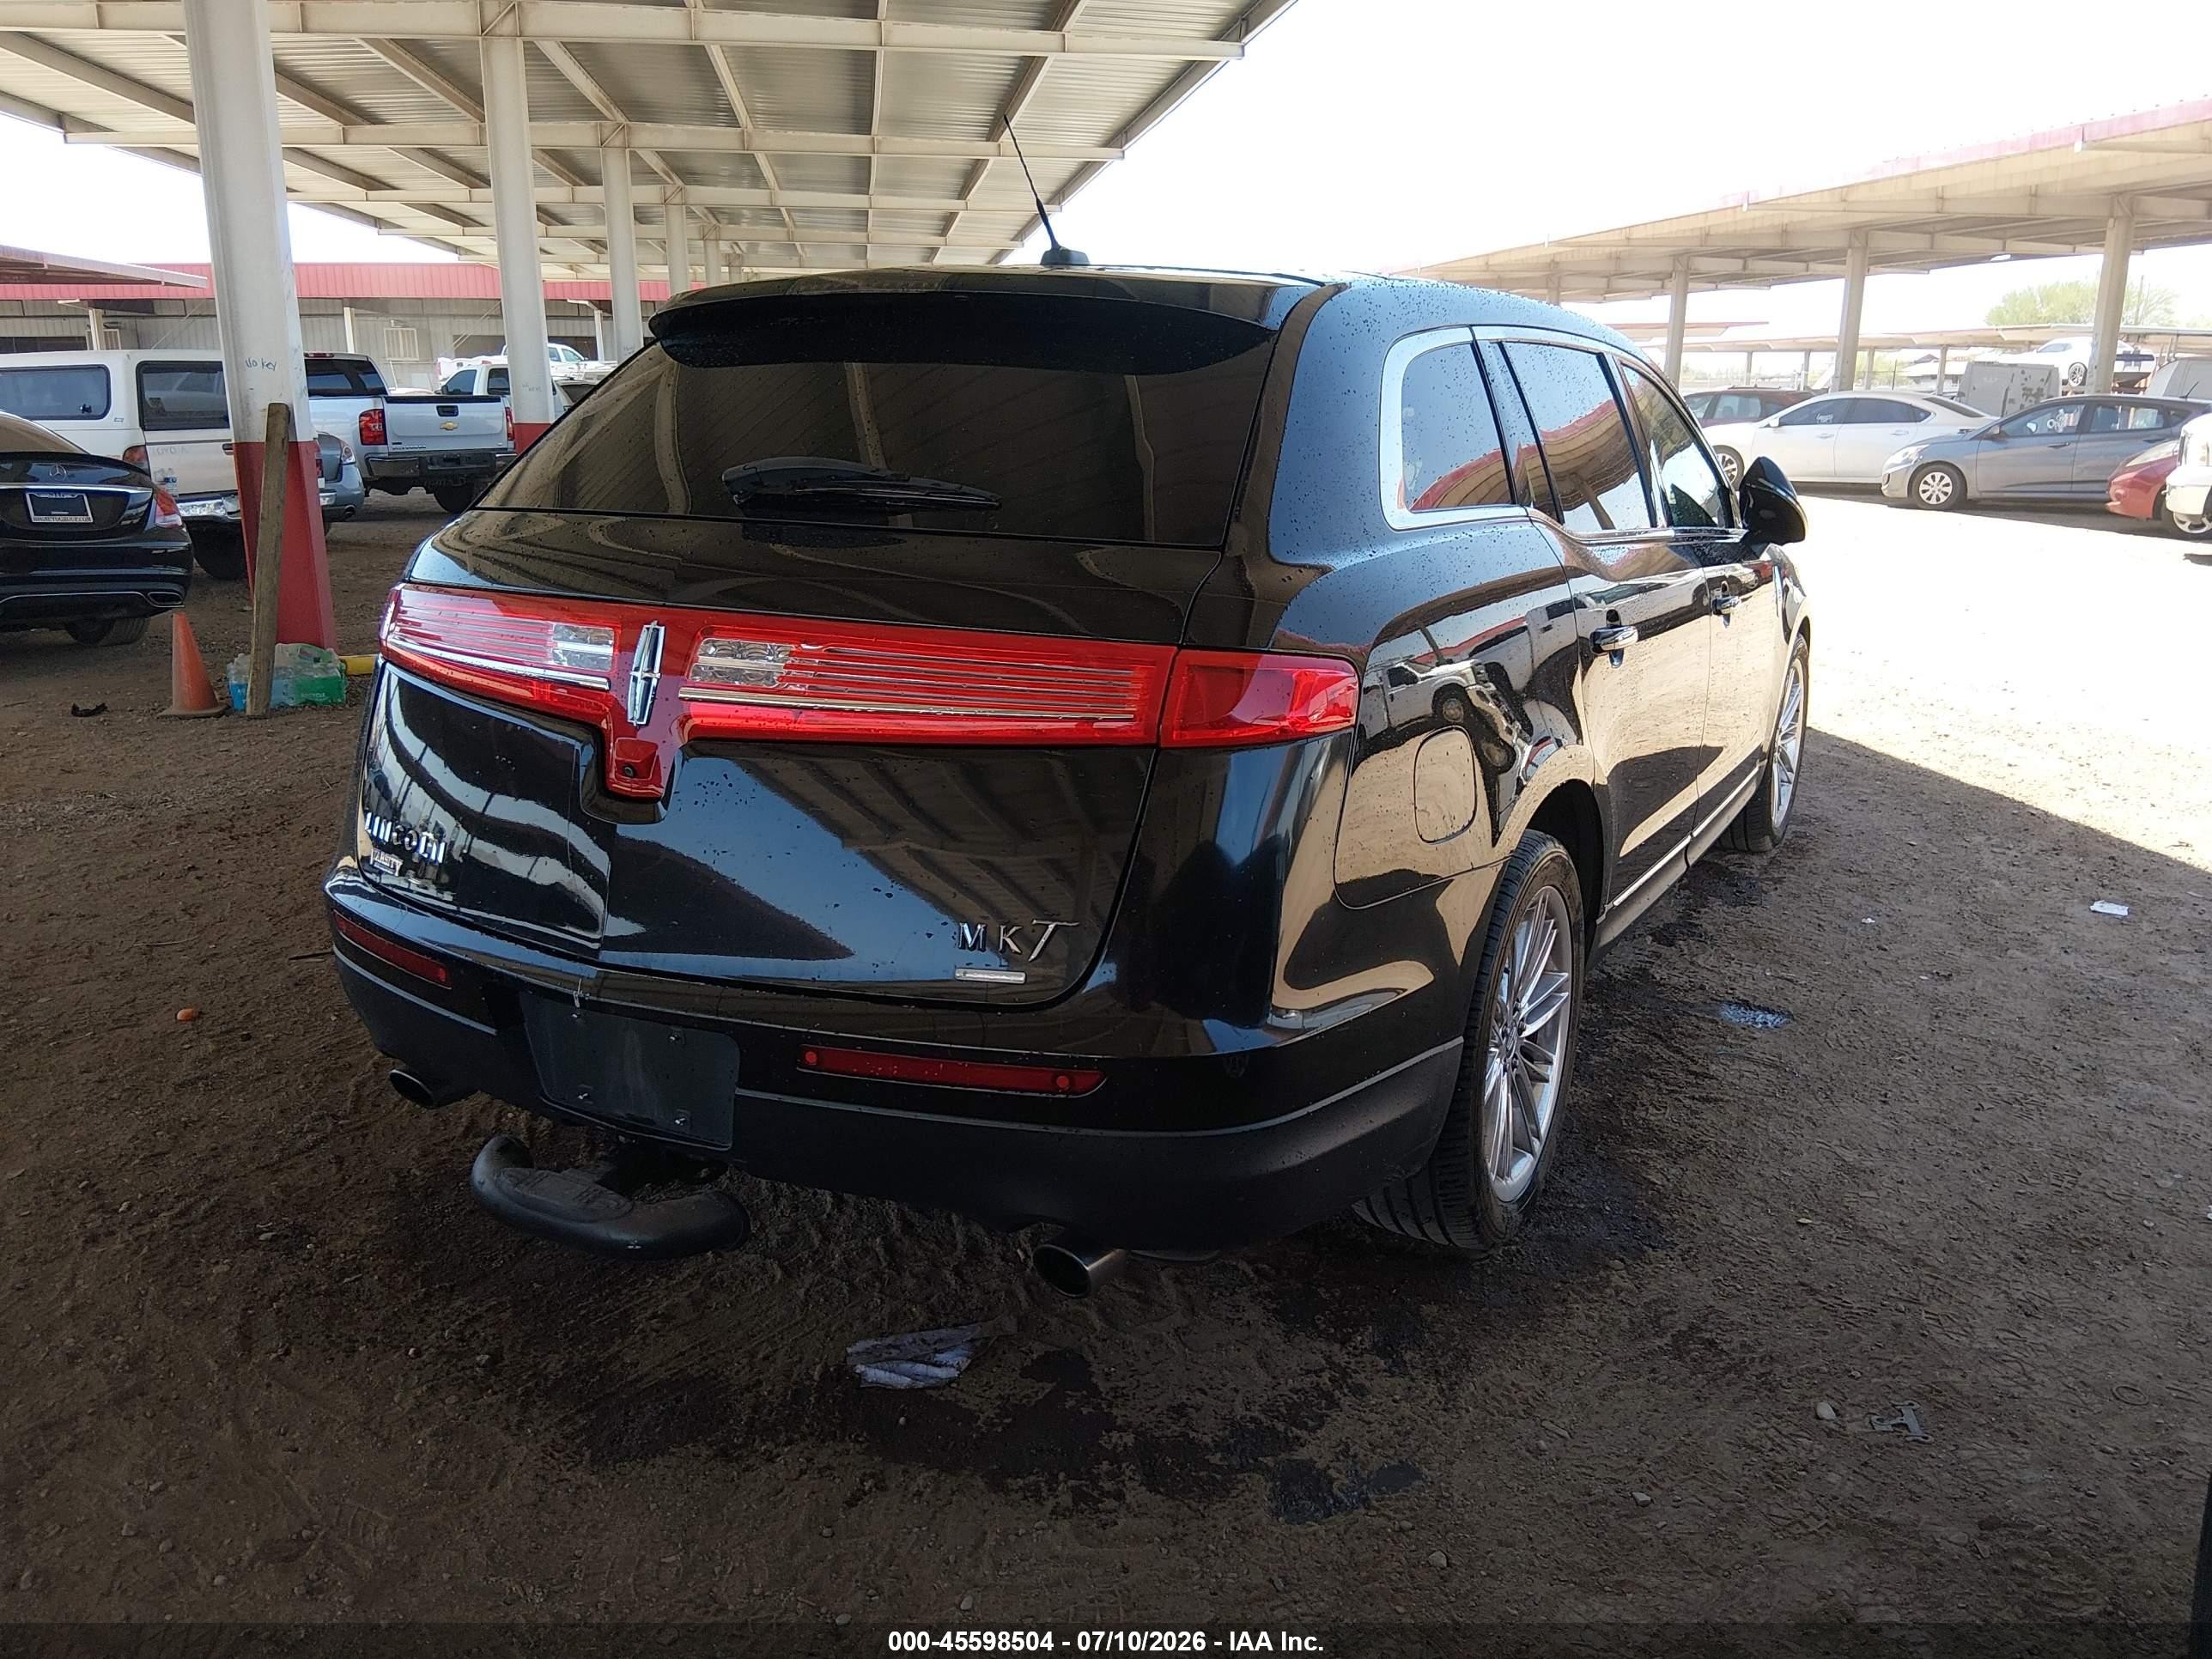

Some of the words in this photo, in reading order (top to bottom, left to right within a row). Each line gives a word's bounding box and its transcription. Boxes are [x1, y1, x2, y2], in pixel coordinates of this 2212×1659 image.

[364, 811, 447, 864] LINCOLN
[369, 848, 404, 876] VARSITY
[958, 920, 1080, 963] MKT
